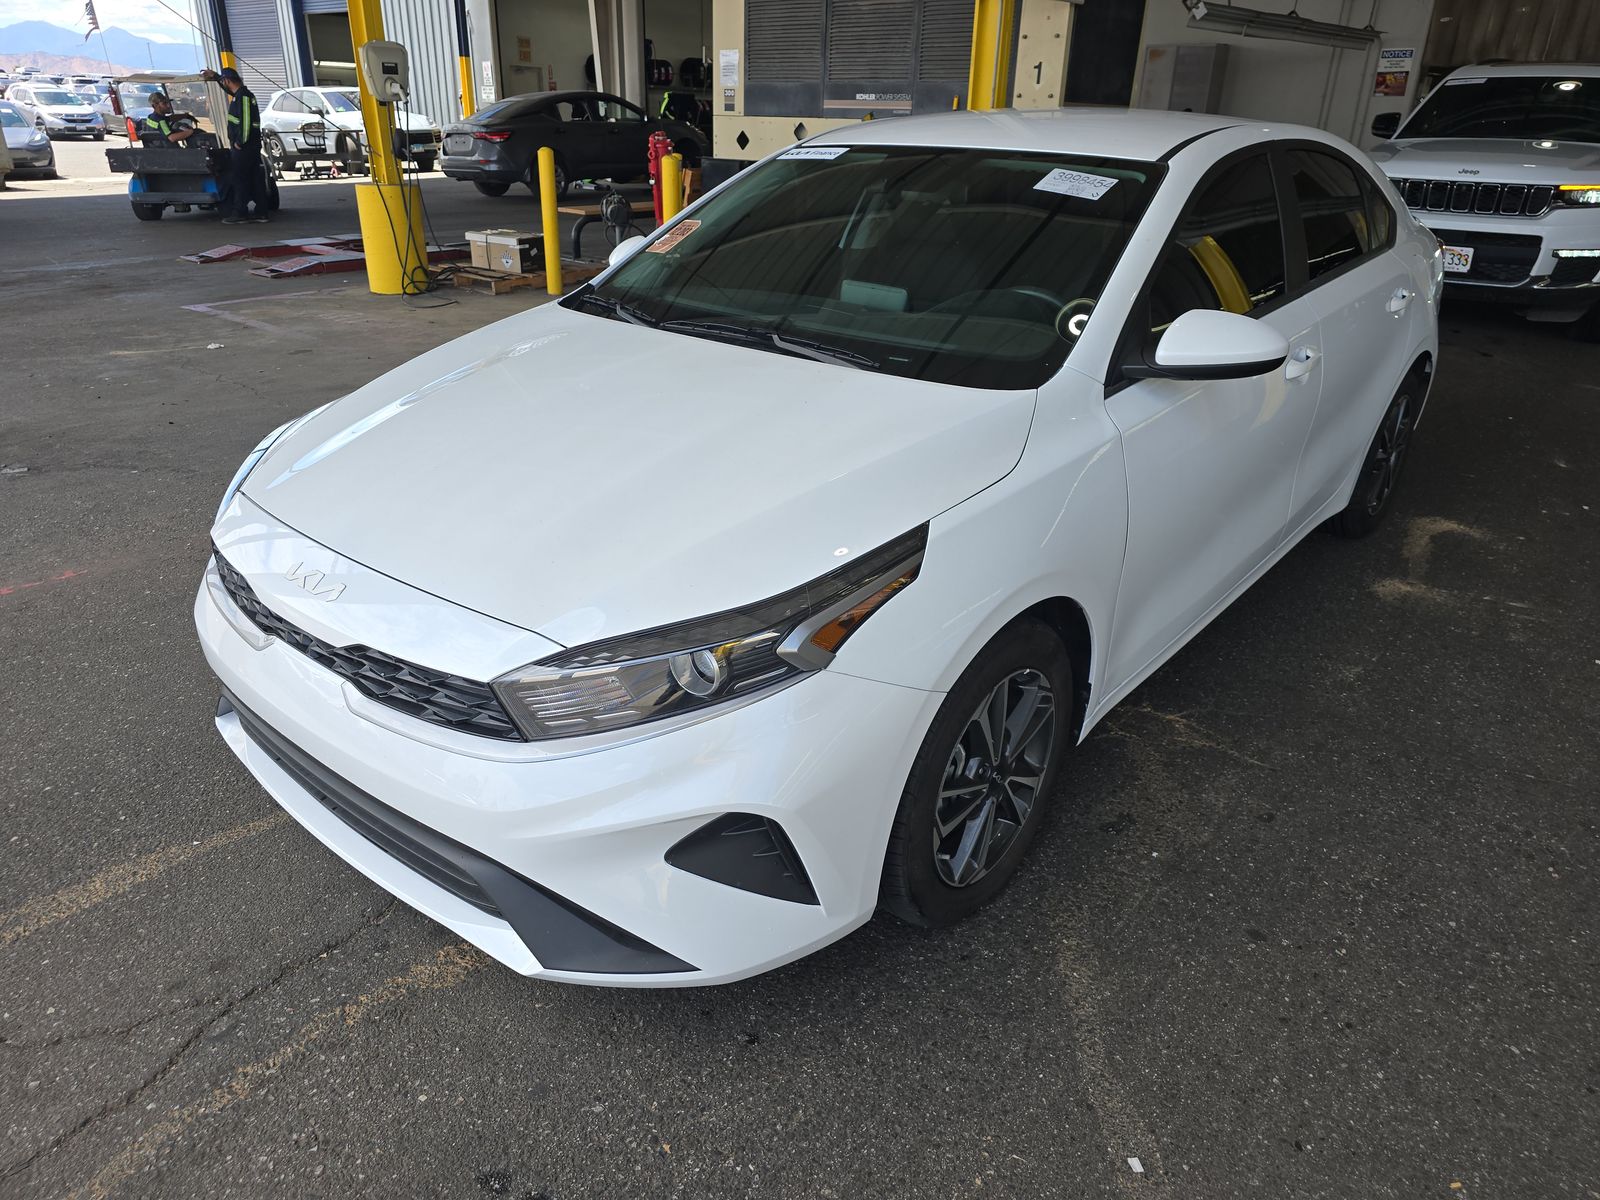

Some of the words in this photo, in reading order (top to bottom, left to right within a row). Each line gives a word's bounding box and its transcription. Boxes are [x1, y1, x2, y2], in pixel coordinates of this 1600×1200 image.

[1034, 61, 1042, 84] 1
[1053, 171, 1114, 188] 3998454
[1447, 253, 1469, 267] 333
